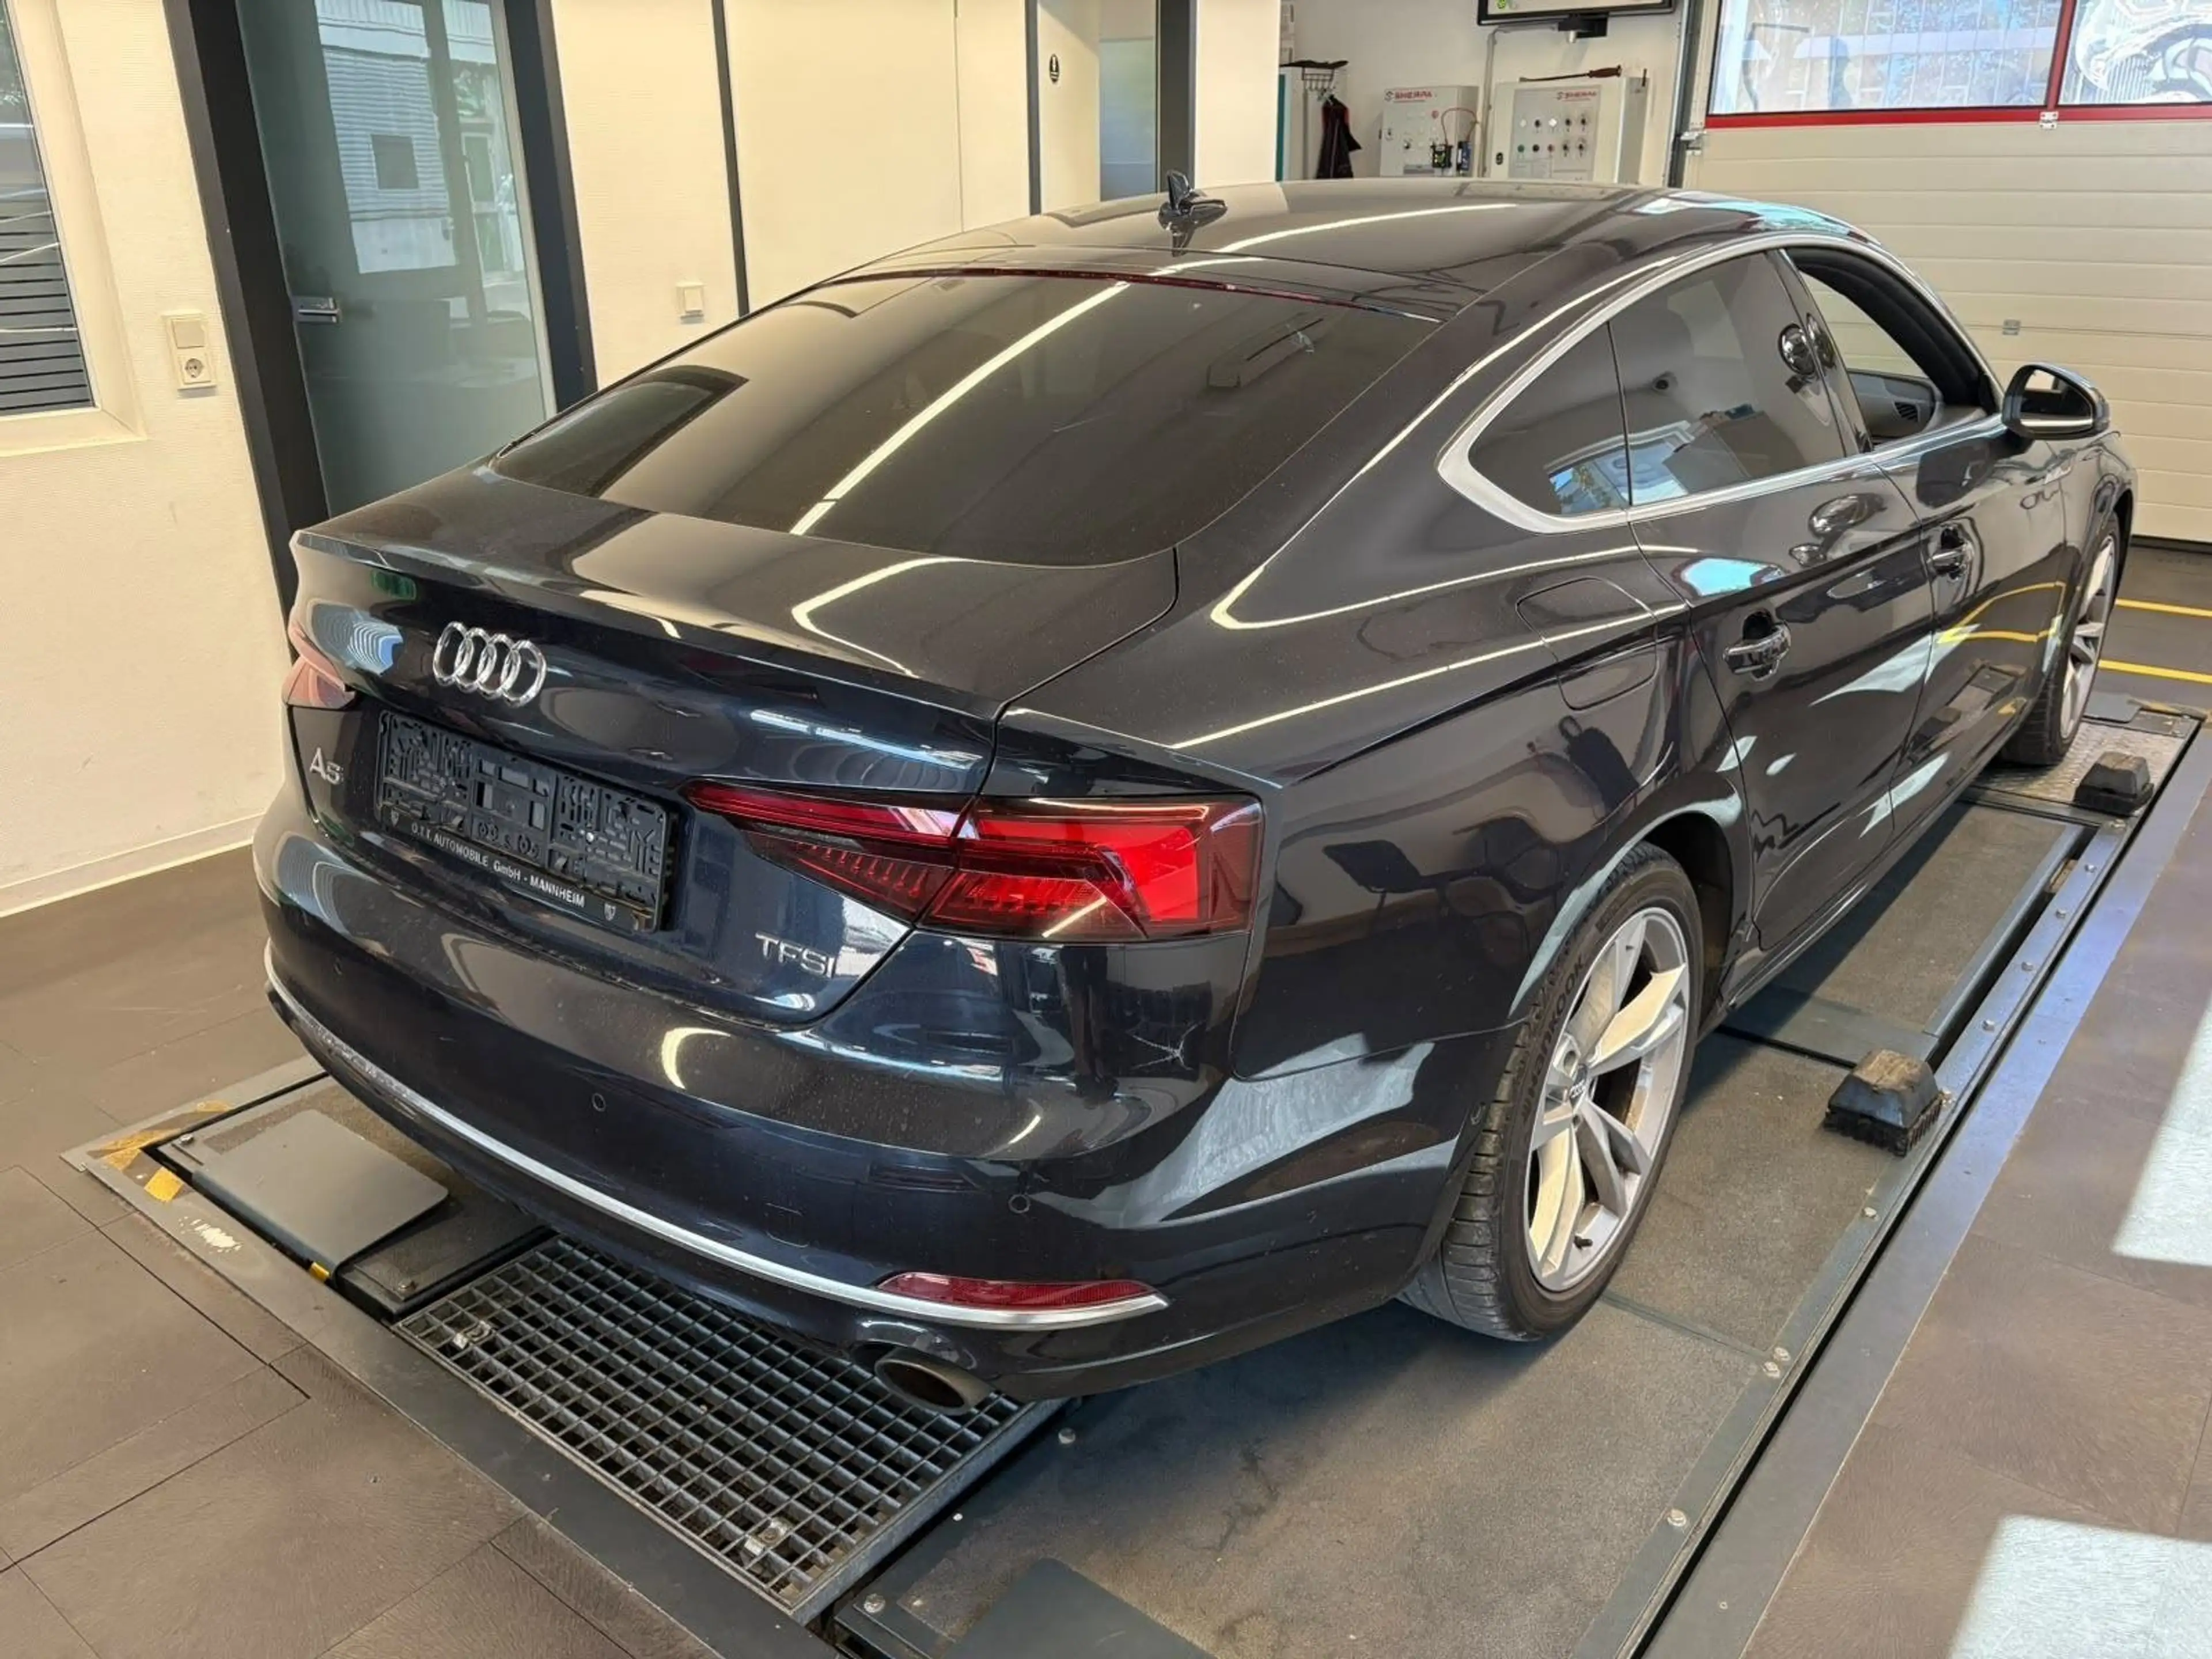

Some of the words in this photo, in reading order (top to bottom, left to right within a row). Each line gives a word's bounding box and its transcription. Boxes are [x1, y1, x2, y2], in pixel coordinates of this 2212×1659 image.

[309, 747, 344, 785] A5
[433, 834, 488, 867] AUTOMOBILE
[493, 860, 521, 881] GmbH
[529, 874, 585, 908] MANNHEIM
[755, 931, 835, 979] TFSI
